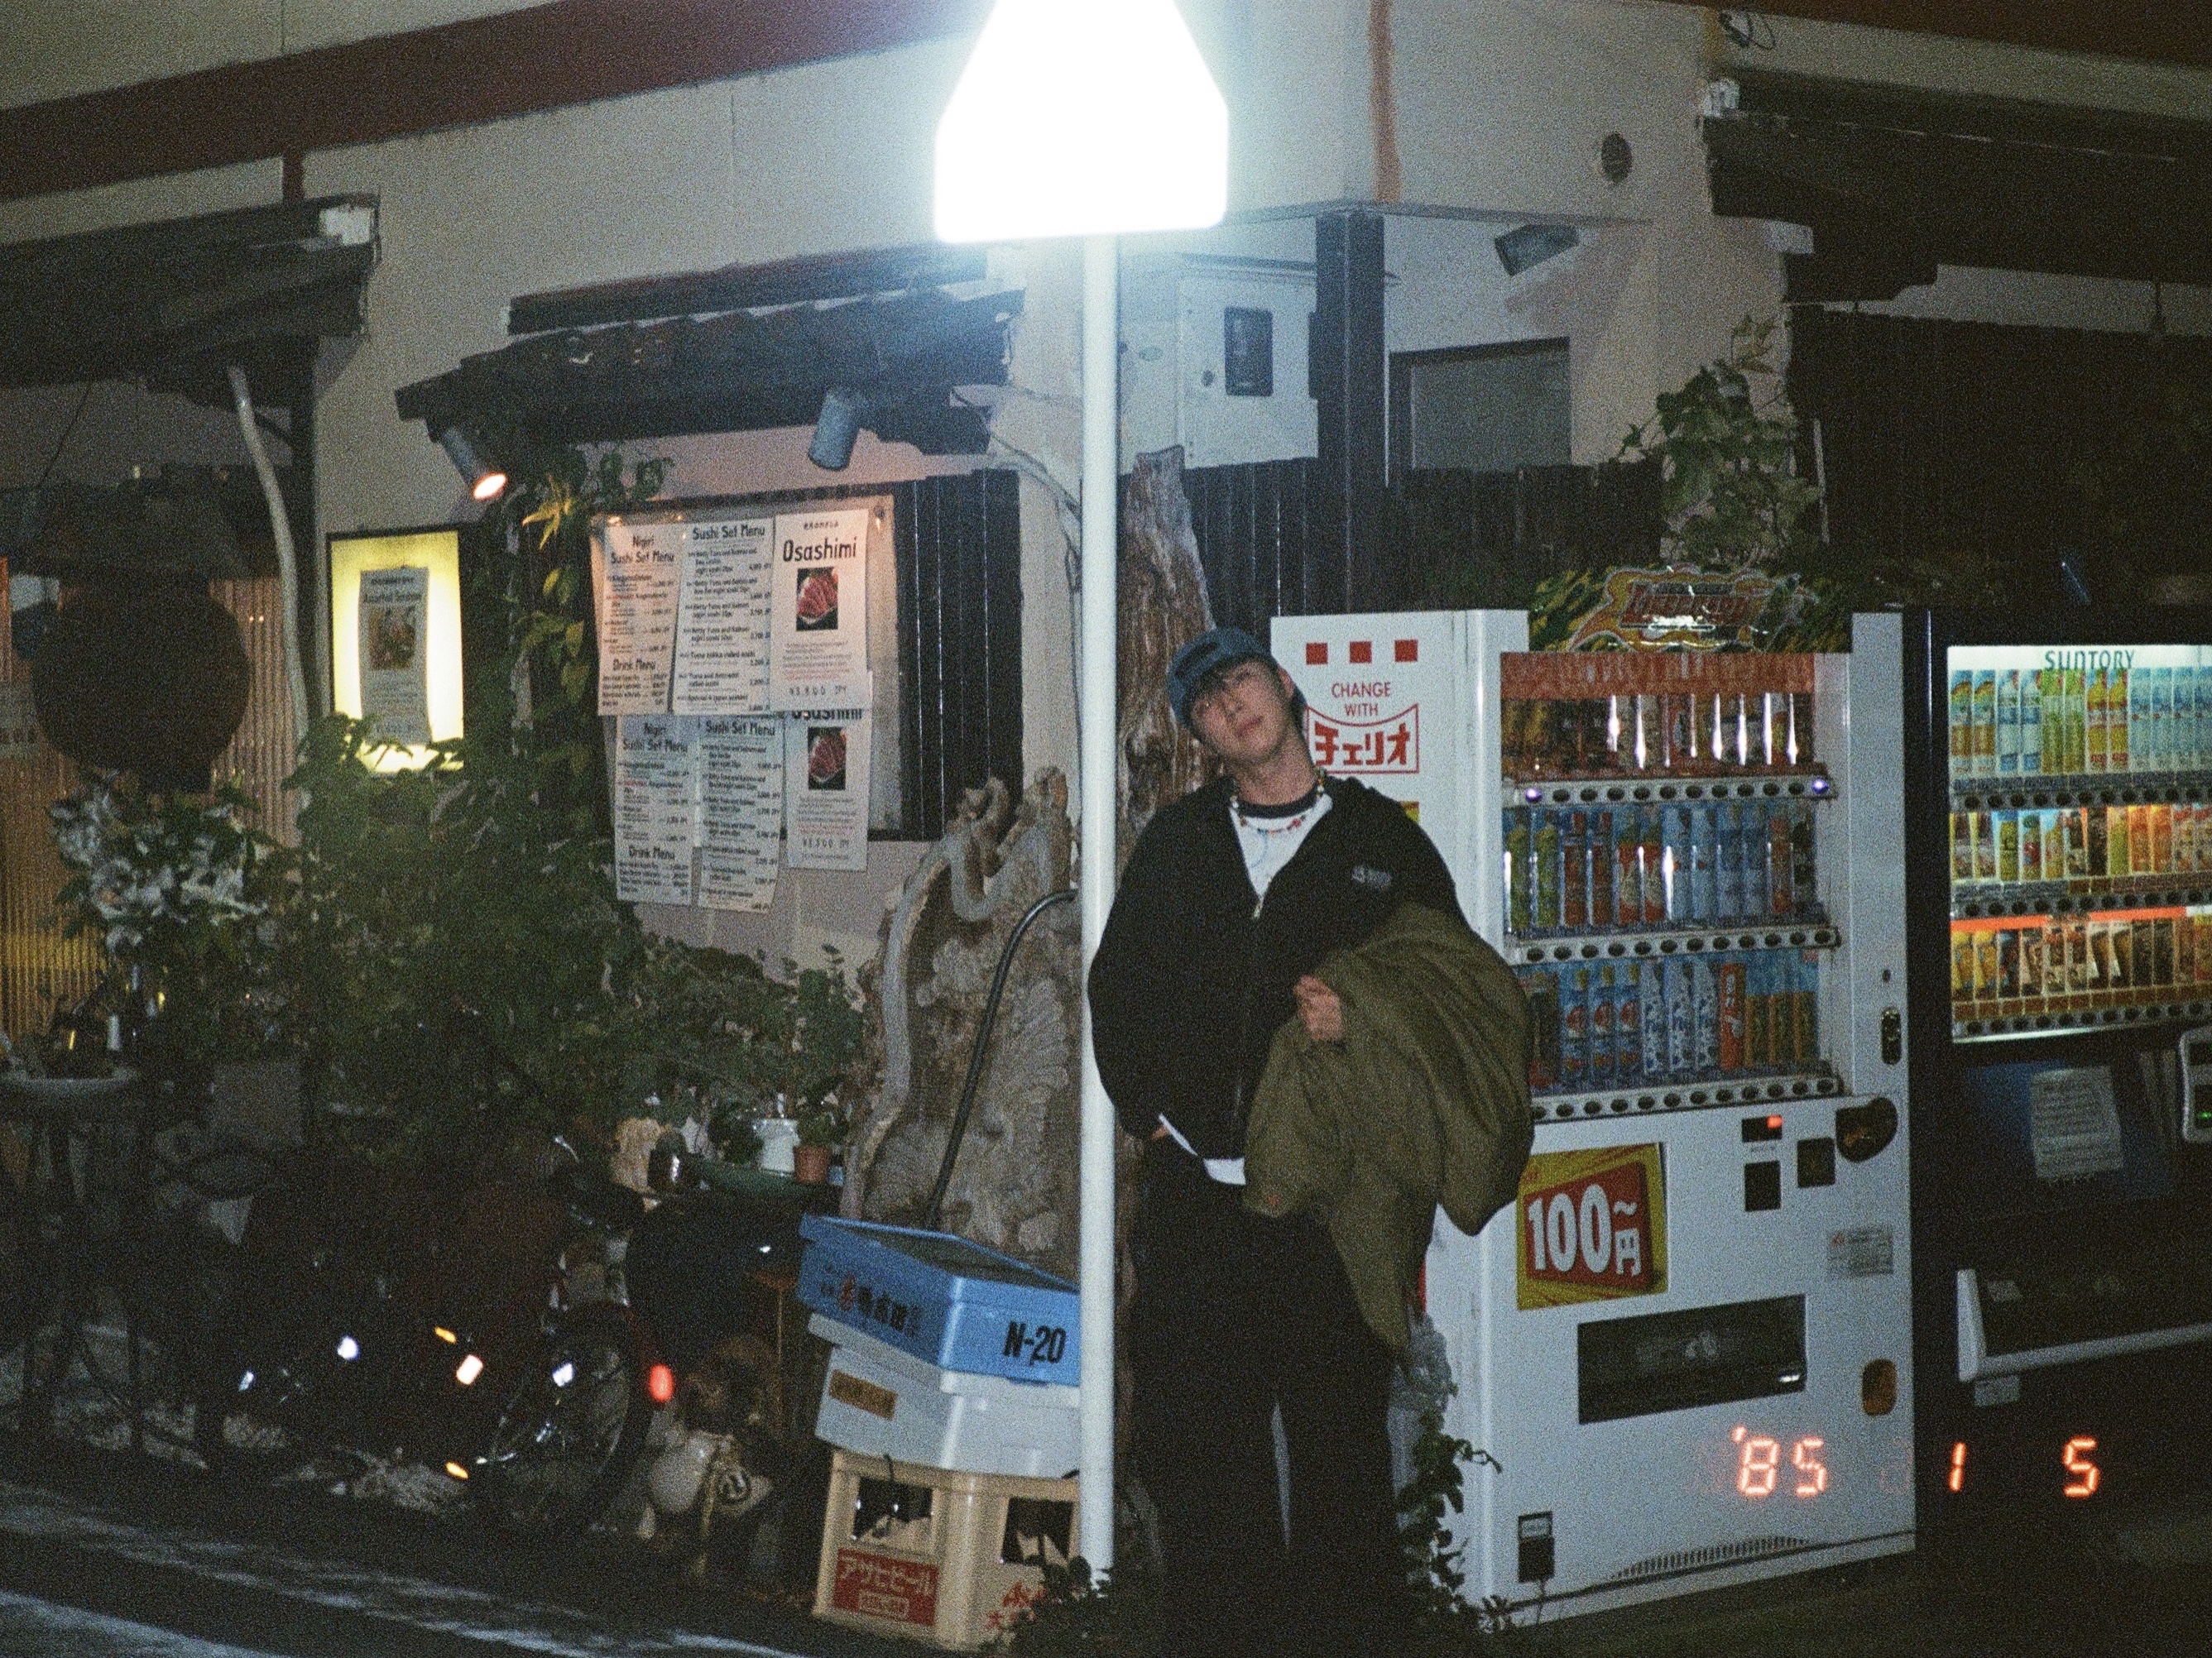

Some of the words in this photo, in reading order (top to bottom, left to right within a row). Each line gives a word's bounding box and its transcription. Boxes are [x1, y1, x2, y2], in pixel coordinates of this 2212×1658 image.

[693, 525, 718, 540] Sushi
[722, 525, 738, 538] Set
[741, 524, 765, 537] Menu
[610, 551, 633, 564] Sushi
[652, 549, 674, 563] Menu
[783, 536, 856, 562] Osashimi
[1331, 681, 1391, 698] CHANGE
[1344, 702, 1379, 716] WITH
[1314, 721, 1410, 766] チェリオ
[1003, 1321, 1067, 1367] N-20
[840, 1555, 934, 1597] アサヒビール
